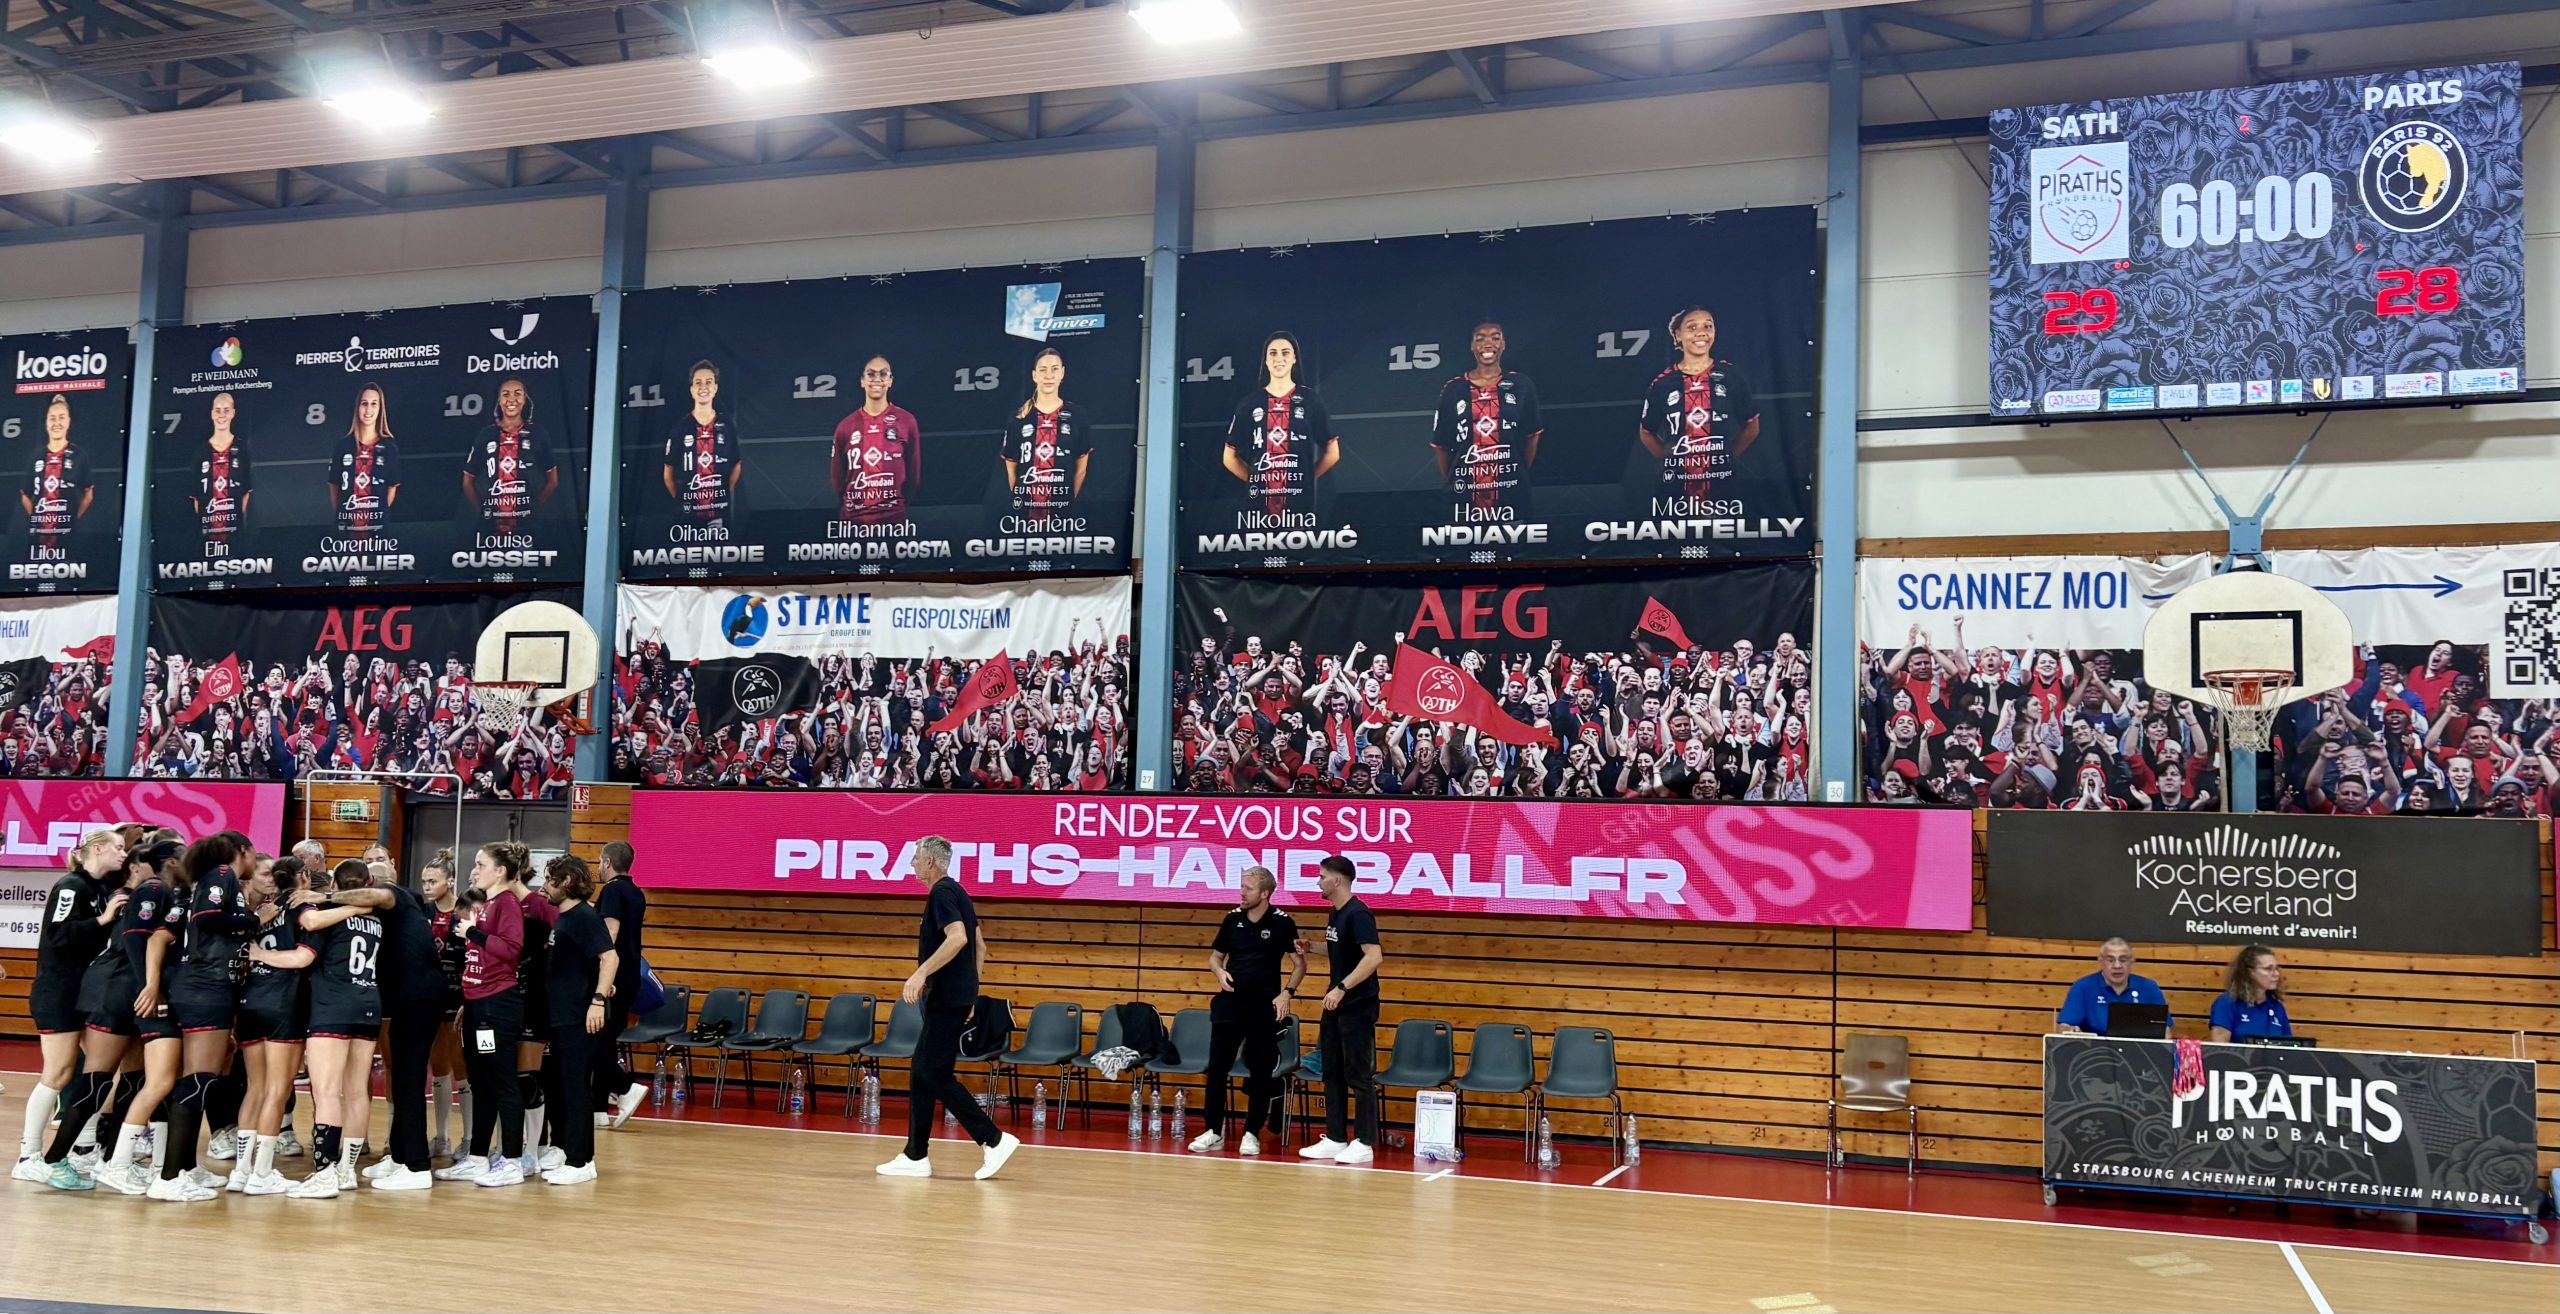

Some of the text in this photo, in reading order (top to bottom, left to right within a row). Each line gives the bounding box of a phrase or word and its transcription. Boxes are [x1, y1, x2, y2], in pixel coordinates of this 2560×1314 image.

[2364, 80, 2463, 111] PARIS
[2043, 111, 2118, 139] SATH
[2239, 114, 2250, 132] 2
[2372, 127, 2453, 158] PARIS 92
[2040, 169, 2123, 201] PIRATHS
[2161, 172, 2333, 249] 60:00
[2376, 267, 2461, 316] 28
[2043, 288, 2118, 335] 29
[1038, 317, 1098, 330] Univer
[296, 352, 344, 365] PIERRES
[366, 344, 440, 361] TERRITOIRES
[1597, 330, 1650, 358] 17
[16, 345, 107, 379] koesio
[365, 362, 389, 370] GROUPE
[416, 359, 440, 367] ALSACE
[467, 350, 559, 374] De Dietrich
[1389, 344, 1441, 371] 15
[204, 368, 258, 381] WEIDMANN
[954, 366, 1000, 391] 13
[1186, 356, 1235, 382] 14
[173, 386, 198, 395] Pompes
[628, 384, 665, 408] 11
[793, 375, 837, 399] 12
[444, 394, 483, 416] 10
[2065, 394, 2097, 404] ALSACE
[163, 413, 181, 434] 7
[306, 404, 326, 424] 8
[2, 418, 21, 438] 6
[1020, 442, 1031, 463] 13
[1460, 444, 1511, 464] Brondani
[1672, 436, 1724, 455] Brondani
[848, 448, 861, 470] 12
[1250, 472, 1304, 483] EURINVEST
[1455, 463, 1518, 477] EURINVEST
[1677, 470, 1733, 480] wienerberger
[684, 490, 726, 500] EURINVEST
[1014, 487, 1069, 495] EURINVEST
[1467, 479, 1518, 490] wienerberger
[338, 511, 383, 520] EURINVEST
[1024, 500, 1069, 510] wienerberger
[1454, 503, 1515, 523] Hawa
[1652, 496, 1744, 518] Mélissa
[827, 519, 917, 539] Elihannah
[1000, 514, 1087, 534] Charlène
[1237, 509, 1317, 530] Nikolina
[1584, 517, 1804, 542] CHANTELLY
[320, 536, 399, 553] Corentine
[476, 531, 534, 549] Louise
[669, 525, 730, 543] Oihana
[1198, 524, 1358, 553] MARKOVIĆ
[1422, 523, 1548, 546] N'DIAYE
[30, 545, 66, 560] Lilou
[205, 541, 229, 557] Elin
[632, 545, 765, 567] MAGENDIE
[788, 540, 952, 562] RODRIGO DA COSTA
[965, 536, 1116, 558] GUERRIER
[158, 557, 273, 579] KARLSSON
[302, 554, 416, 573] CAVALIER
[451, 550, 558, 568] CUSSET
[9, 562, 87, 579] BEGON
[1898, 571, 2128, 610] SCANNEZ MOI
[777, 592, 871, 628] STANE
[892, 607, 1010, 629] GEISPOLSHEIM
[1407, 583, 1549, 640] AEG
[0, 619, 29, 638] HEIM
[315, 605, 412, 651] AEG
[830, 629, 854, 637] GROUPE
[1055, 803, 1413, 843] RENDEZ-VOUS SUR
[2136, 859, 2357, 900] Kochersberg
[2169, 888, 2333, 917] Ackerland
[10, 922, 24, 933] 06
[26, 923, 40, 934] 95
[2186, 920, 2280, 937] Résolument
[349, 936, 381, 980] 64
[481, 1039, 493, 1048] As
[2172, 1070, 2403, 1143] PIRATHS
[1923, 1139, 1936, 1149] 22
[2072, 1163, 2522, 1206] STRASBOURG ACHENHEIM TRUCHTERSHEIM HANDBALL
